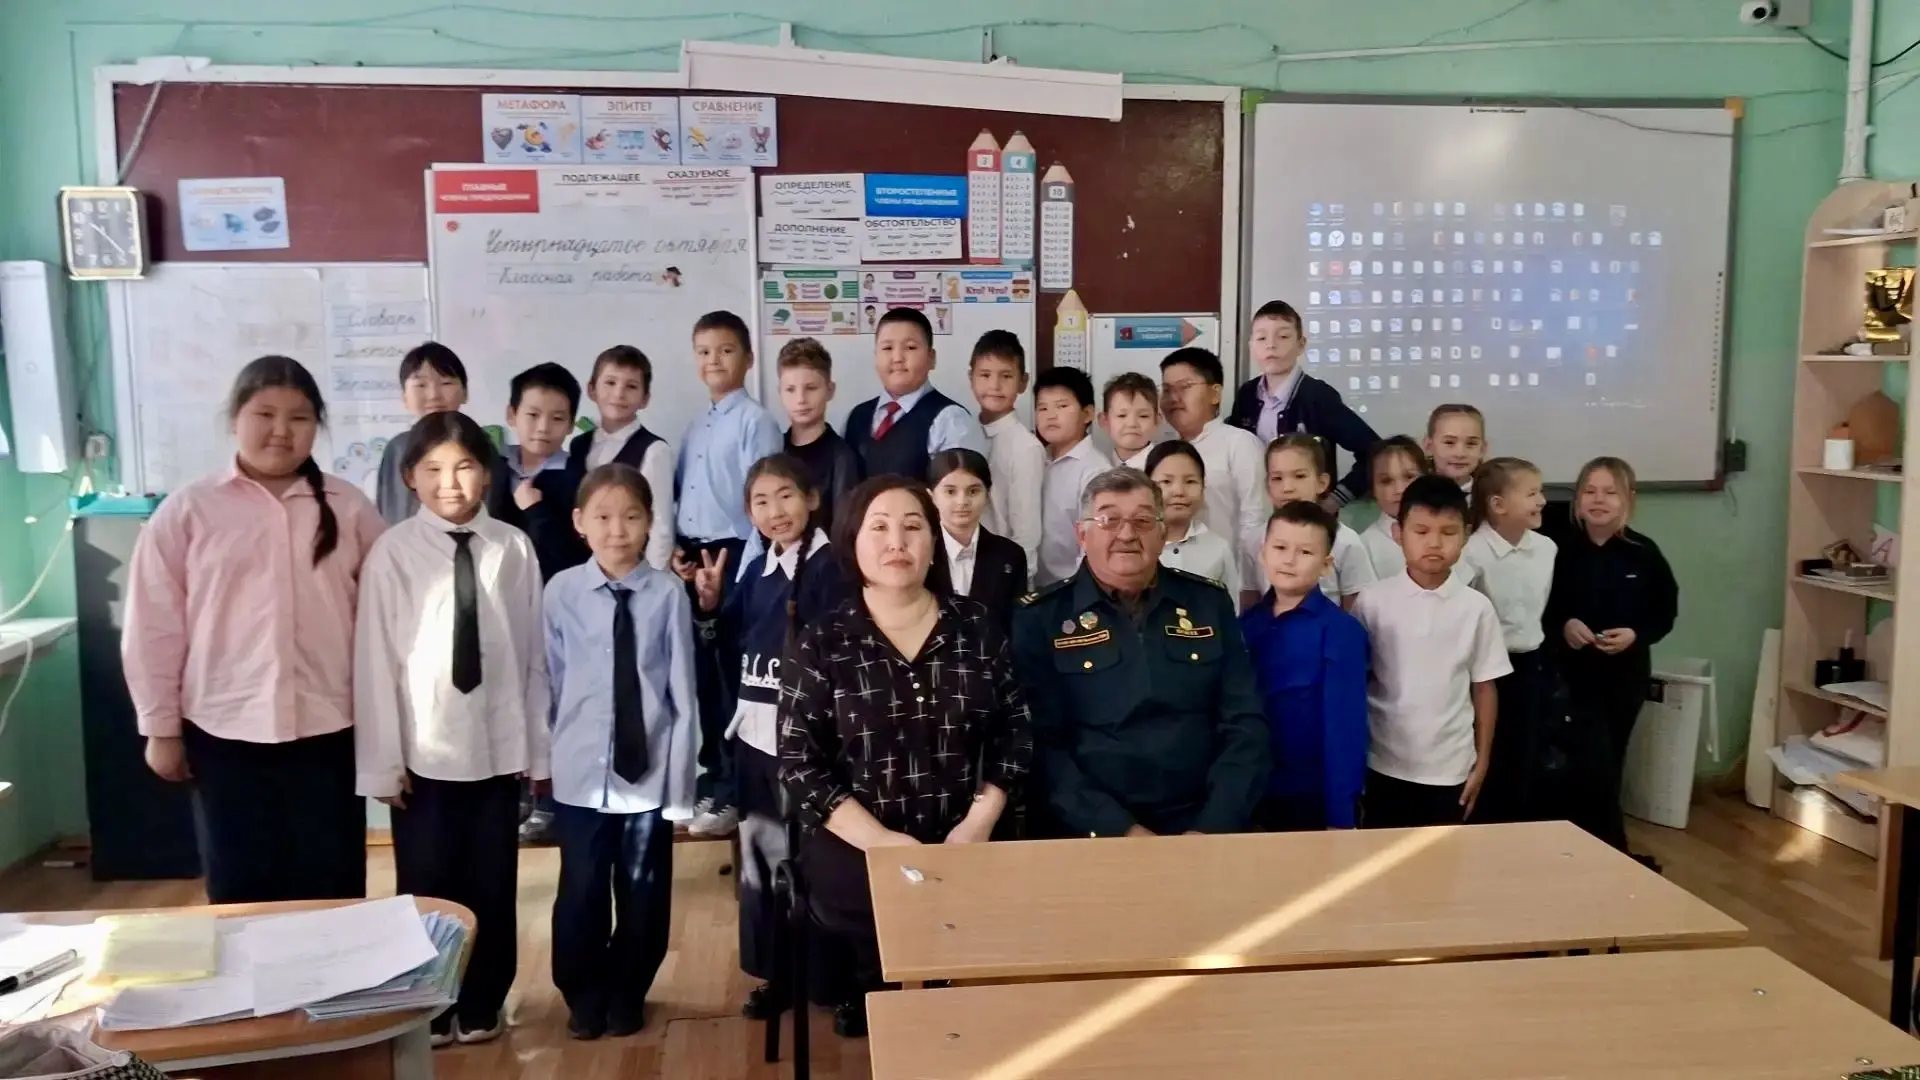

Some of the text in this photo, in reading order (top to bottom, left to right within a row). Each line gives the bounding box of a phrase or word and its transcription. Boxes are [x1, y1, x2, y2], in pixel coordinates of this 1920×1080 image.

[496, 99, 567, 111] МЕТАФОРА
[607, 100, 653, 112] ЭПИТЕТ
[692, 101, 764, 113] СРАВНЕНИЕ
[561, 173, 641, 183] ПОДЛЕЖАЩЕЕ
[667, 169, 731, 179] СКАЗУЕМОЕ
[774, 180, 852, 190] ОПРЕДЕЛЕНИЕ
[774, 223, 847, 234] ДОПОЛНЕНИЕ
[864, 218, 957, 228] ОБСТОЯТЕЛЬСТВО
[486, 229, 647, 261] Четырнадцатое
[654, 229, 748, 265] октября
[499, 264, 653, 284] Классная работа
